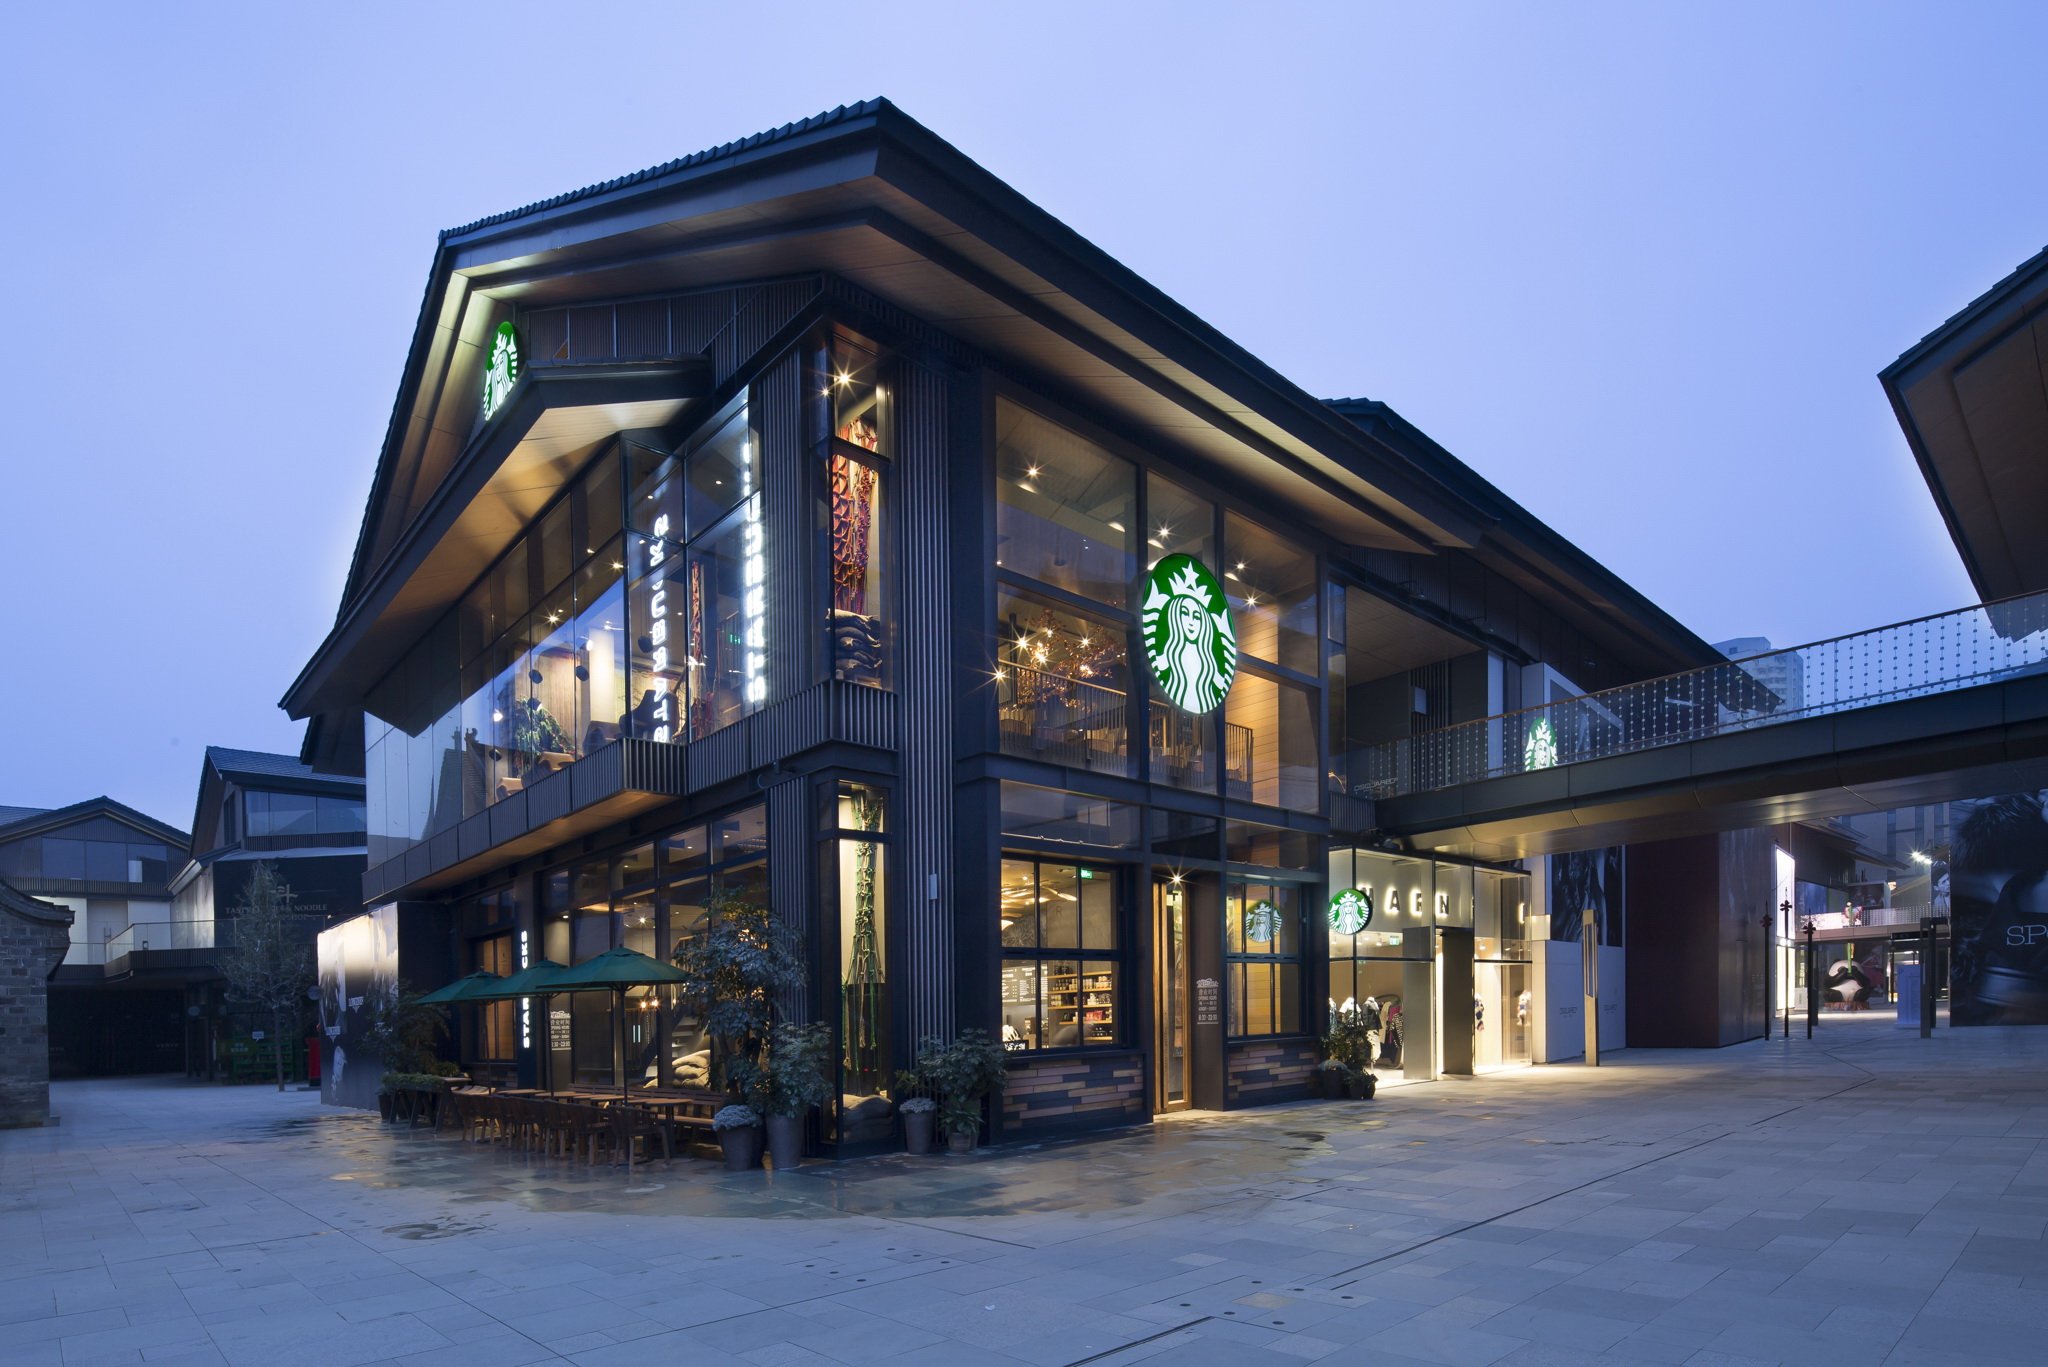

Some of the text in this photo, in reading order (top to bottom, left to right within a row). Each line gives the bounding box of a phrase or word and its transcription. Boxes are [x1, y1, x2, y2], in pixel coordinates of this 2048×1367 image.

[294, 903, 328, 913] NOODLE
[2006, 924, 2048, 946] SP
[521, 930, 530, 1048] STARCKS
